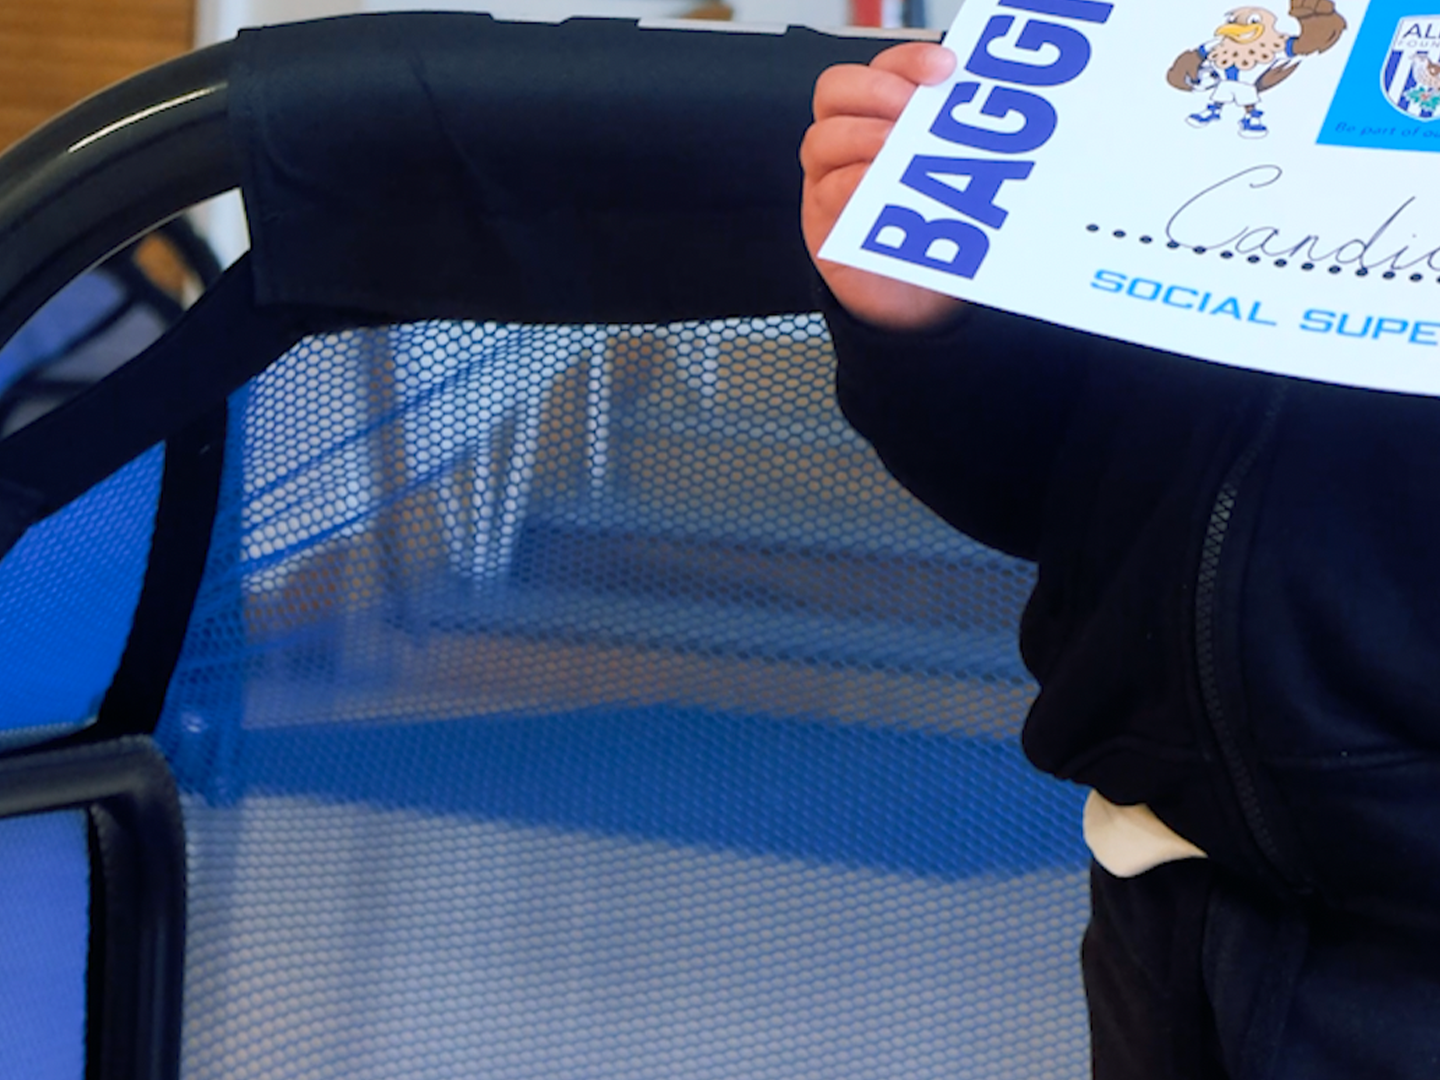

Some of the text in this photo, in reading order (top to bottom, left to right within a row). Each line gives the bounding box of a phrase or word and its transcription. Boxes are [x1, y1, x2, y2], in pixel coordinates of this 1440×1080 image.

[1335, 121, 1356, 132] Be
[1360, 126, 1396, 137] part
[1401, 126, 1421, 137] of
[1090, 269, 1277, 325] SOCIAL
